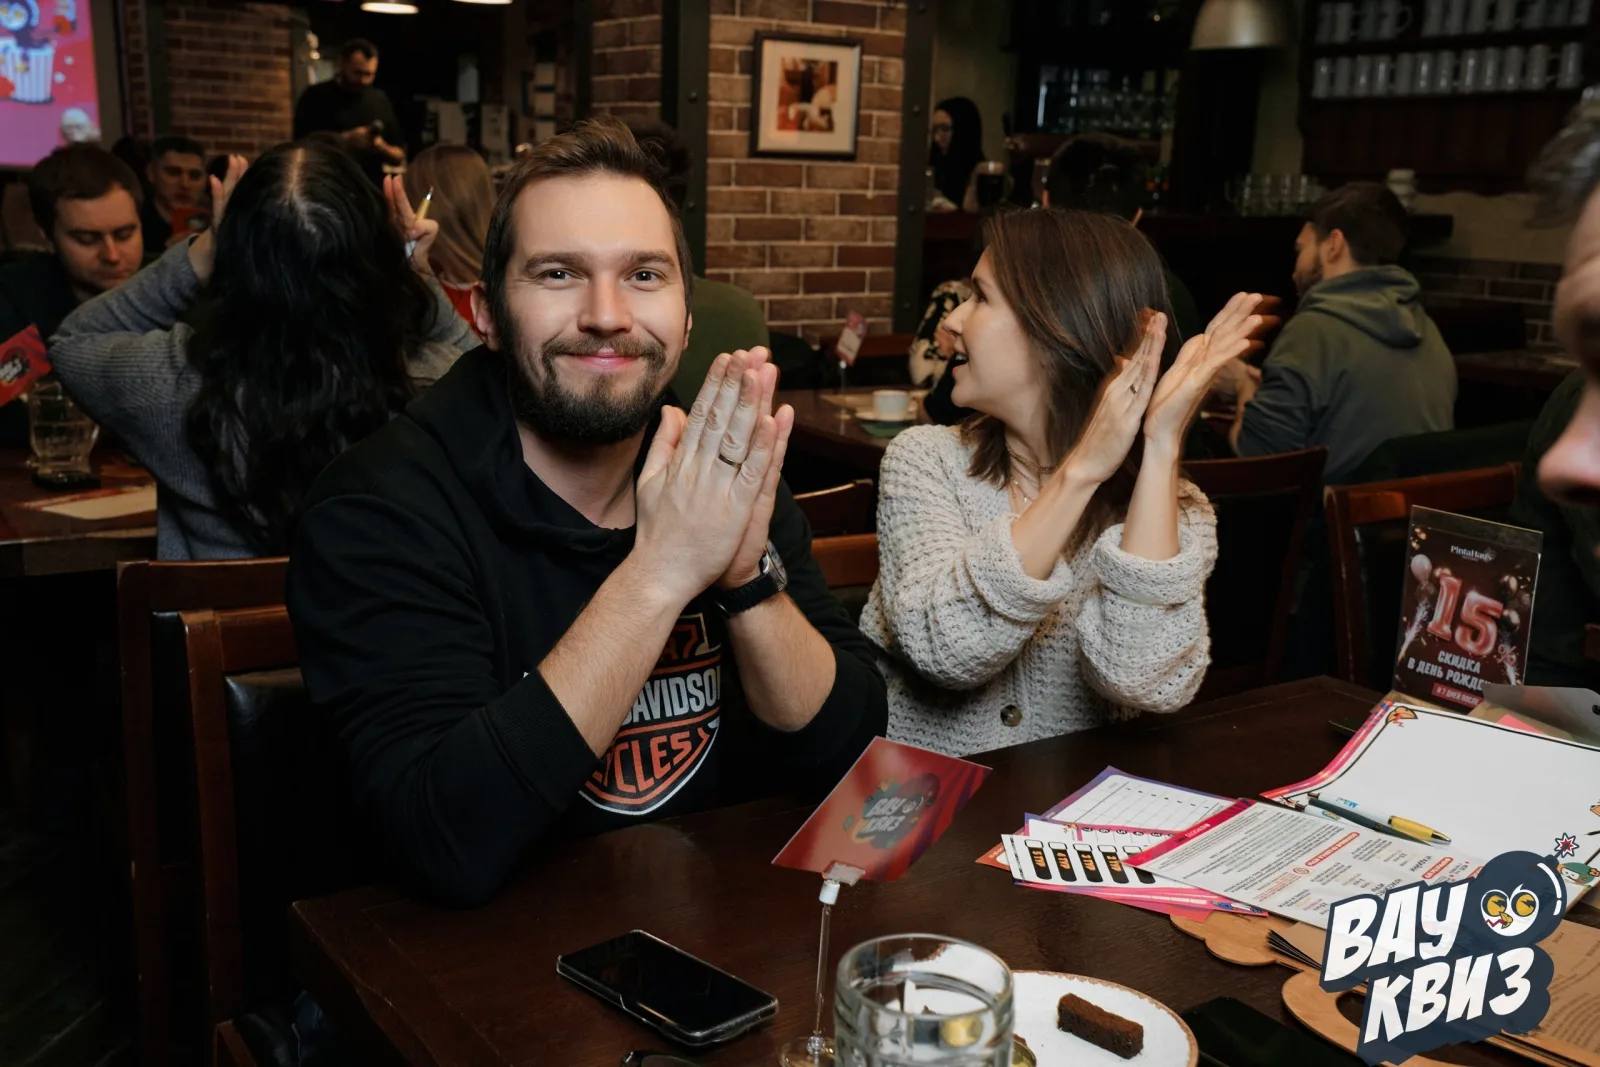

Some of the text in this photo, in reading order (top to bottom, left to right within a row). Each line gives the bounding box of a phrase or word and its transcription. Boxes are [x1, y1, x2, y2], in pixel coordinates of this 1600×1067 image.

[1407, 656, 1492, 692] В ДЕНЬ РОЖДЕ
[1437, 650, 1481, 673] СКИДКА
[622, 665, 721, 726] AVIDSO
[592, 731, 693, 794] YCLES
[864, 797, 908, 818] ВАУ
[860, 815, 906, 832] КВИЗ
